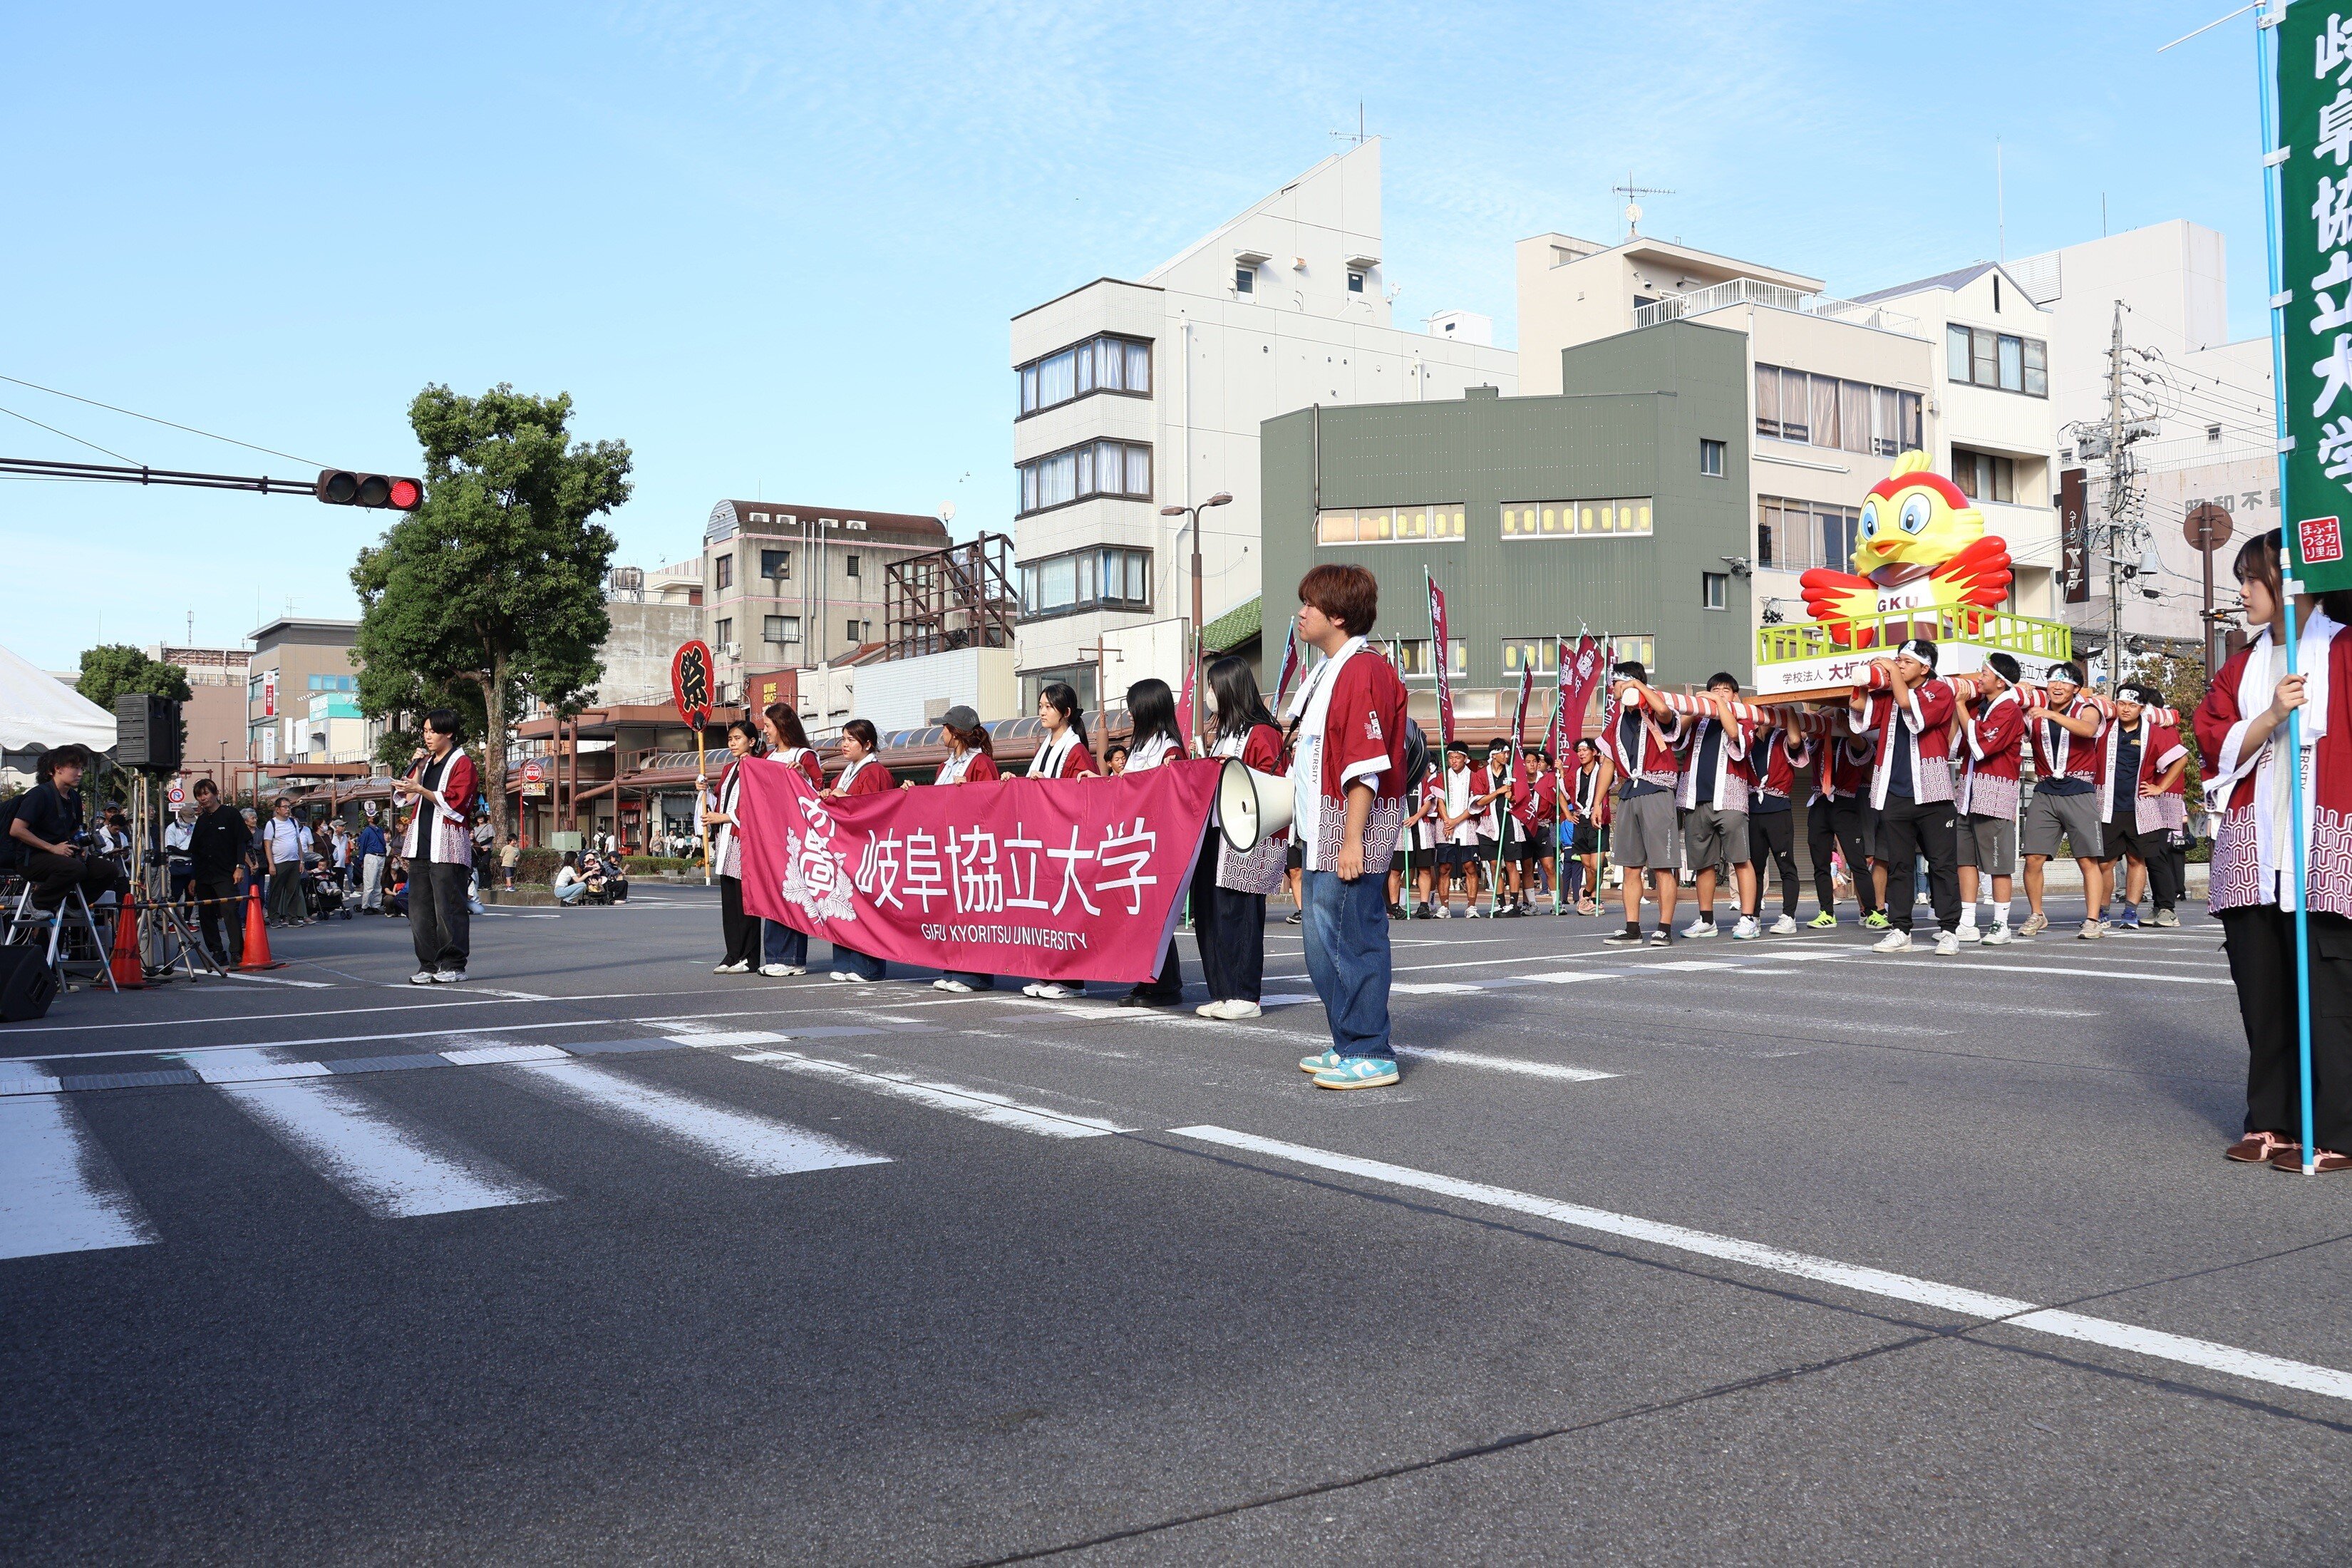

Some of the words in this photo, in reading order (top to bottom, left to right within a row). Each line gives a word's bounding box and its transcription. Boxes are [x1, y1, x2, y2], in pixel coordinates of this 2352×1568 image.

[2303, 525, 2315, 559] まつり
[2313, 524, 2325, 557] ふる里
[2324, 521, 2338, 556] 十万石
[1877, 596, 1919, 613] GKU
[763, 683, 777, 692] WINE
[1783, 669, 1823, 684] 学校法人
[2300, 745, 2311, 790] ERSITY
[855, 817, 1157, 917] 岐阜協立大学
[921, 923, 947, 942] GIFU
[949, 924, 1011, 944] KYORITSU
[1013, 926, 1088, 951] UNIVERSITY
